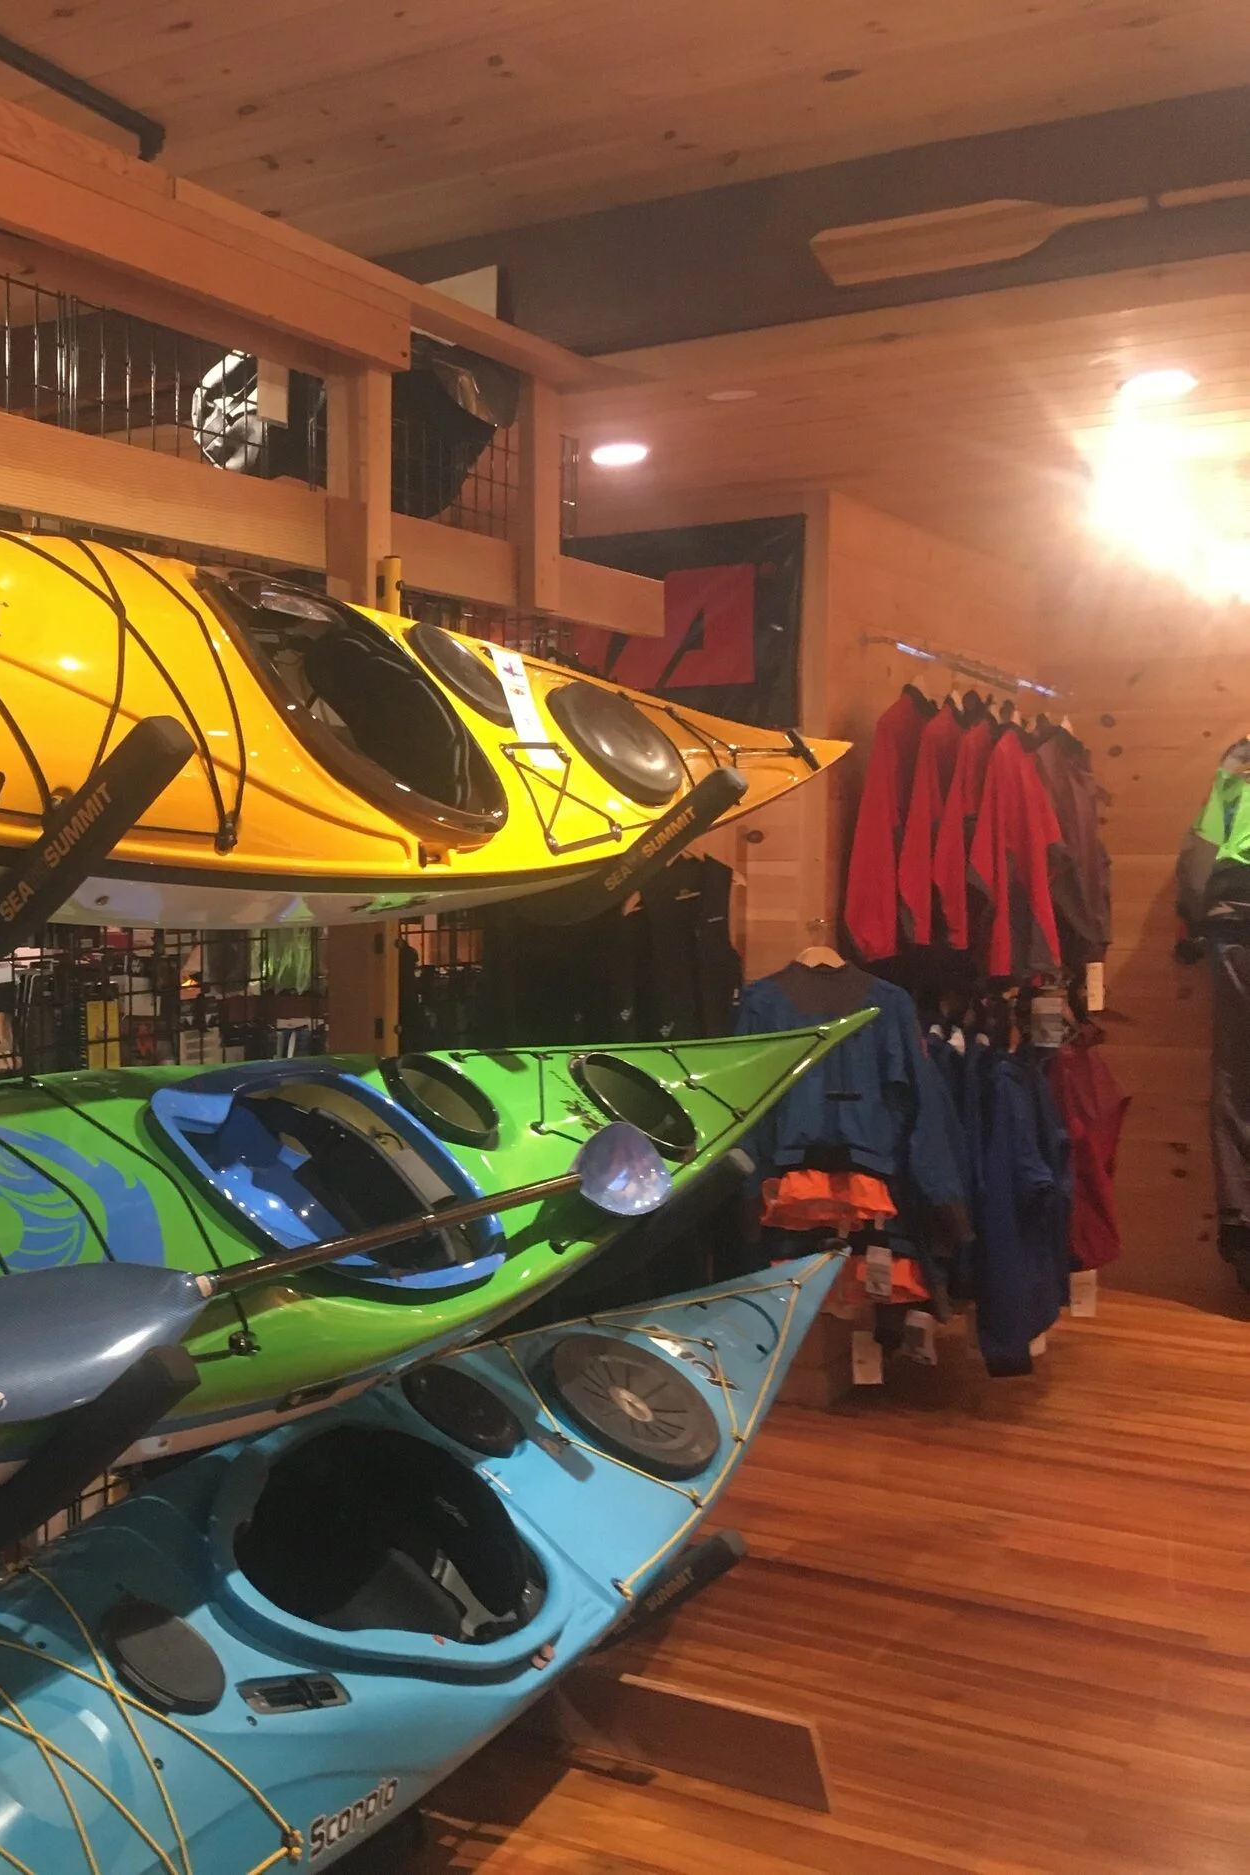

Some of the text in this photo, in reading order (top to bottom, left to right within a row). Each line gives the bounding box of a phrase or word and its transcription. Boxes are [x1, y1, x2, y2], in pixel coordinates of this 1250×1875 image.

[0, 880, 35, 922] SEA
[43, 782, 112, 869] SUMMIT
[641, 806, 696, 859] SUMMIT
[308, 1776, 398, 1863] Scorpio
